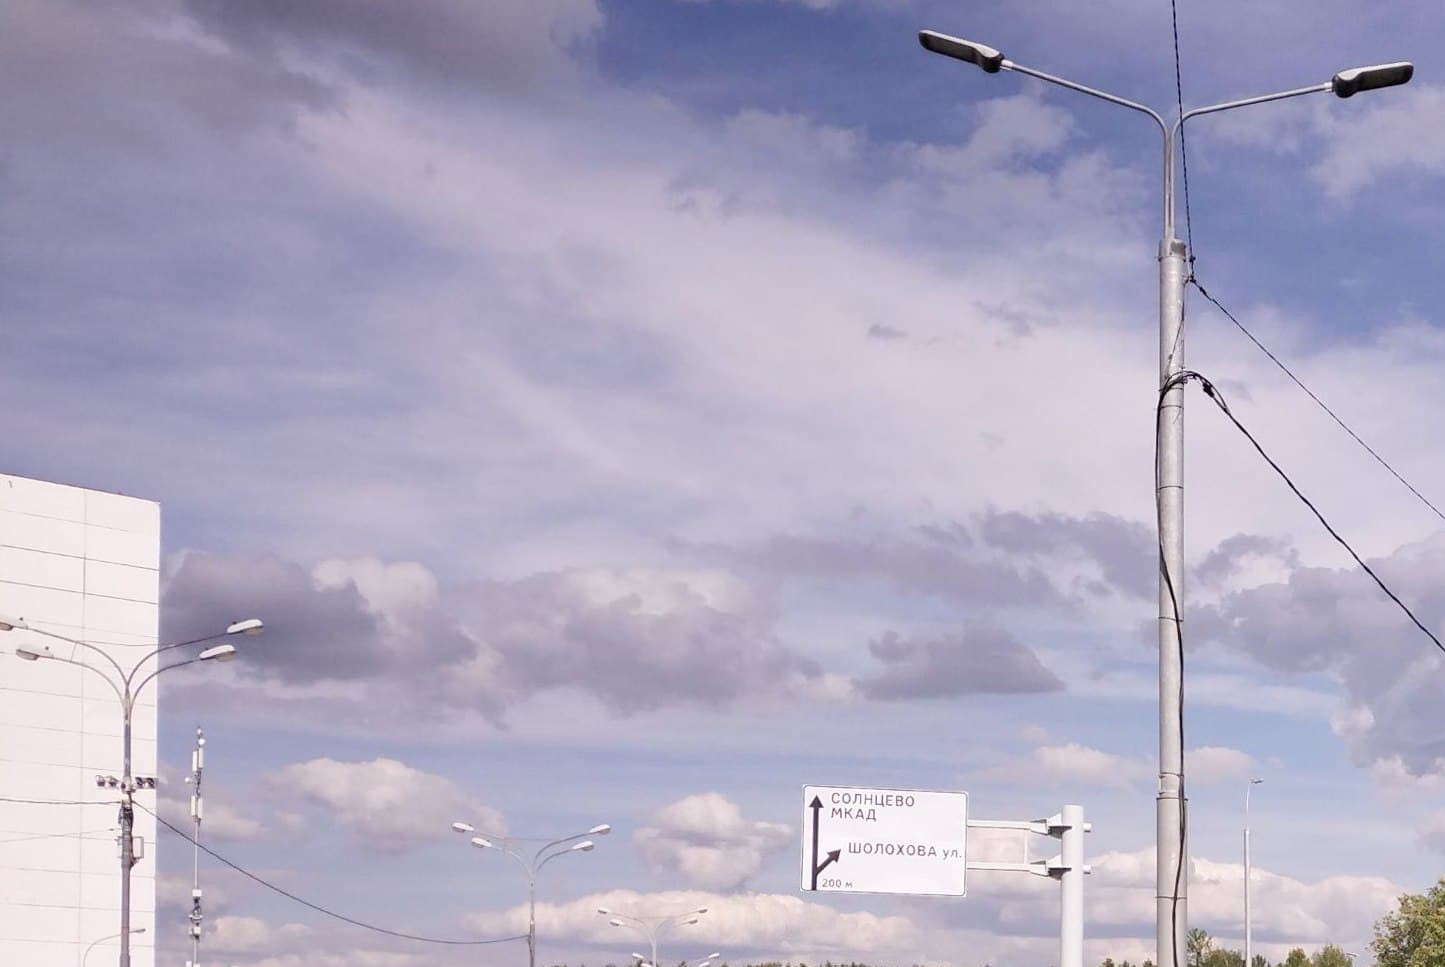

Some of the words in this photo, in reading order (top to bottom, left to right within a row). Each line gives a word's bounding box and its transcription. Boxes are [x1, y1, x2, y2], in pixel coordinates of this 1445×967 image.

[831, 792, 915, 807] СОЛНЦЕВО
[831, 808, 877, 822] МКАД
[848, 842, 937, 857] ШОЛОХОВА
[943, 849, 962, 860] ул.
[822, 879, 842, 888] 200
